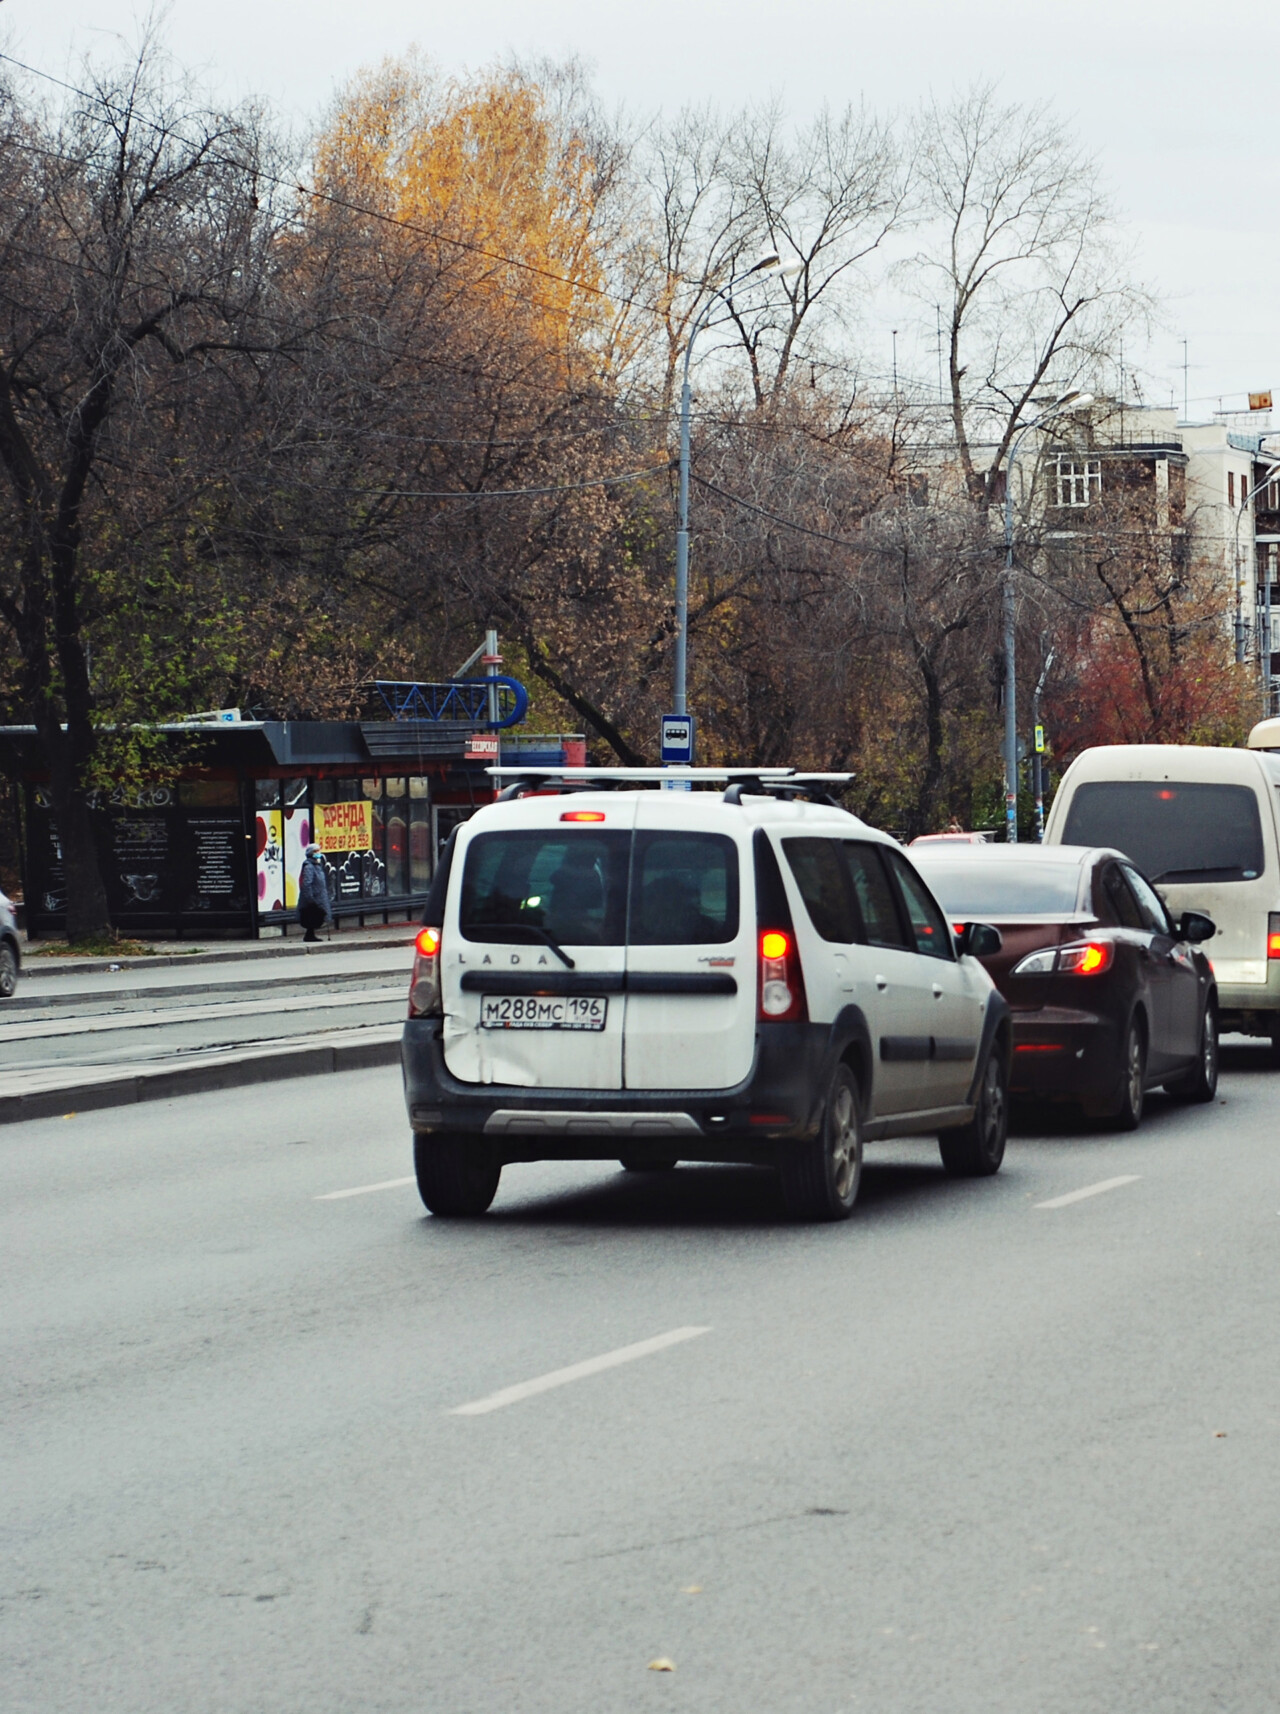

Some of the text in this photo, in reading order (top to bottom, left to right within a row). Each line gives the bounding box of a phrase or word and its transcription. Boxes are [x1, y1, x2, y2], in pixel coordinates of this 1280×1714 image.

[323, 803, 366, 831] АРЕНДА
[348, 834, 356, 848] 23
[458, 953, 548, 965] LADA
[569, 999, 600, 1016] 196
